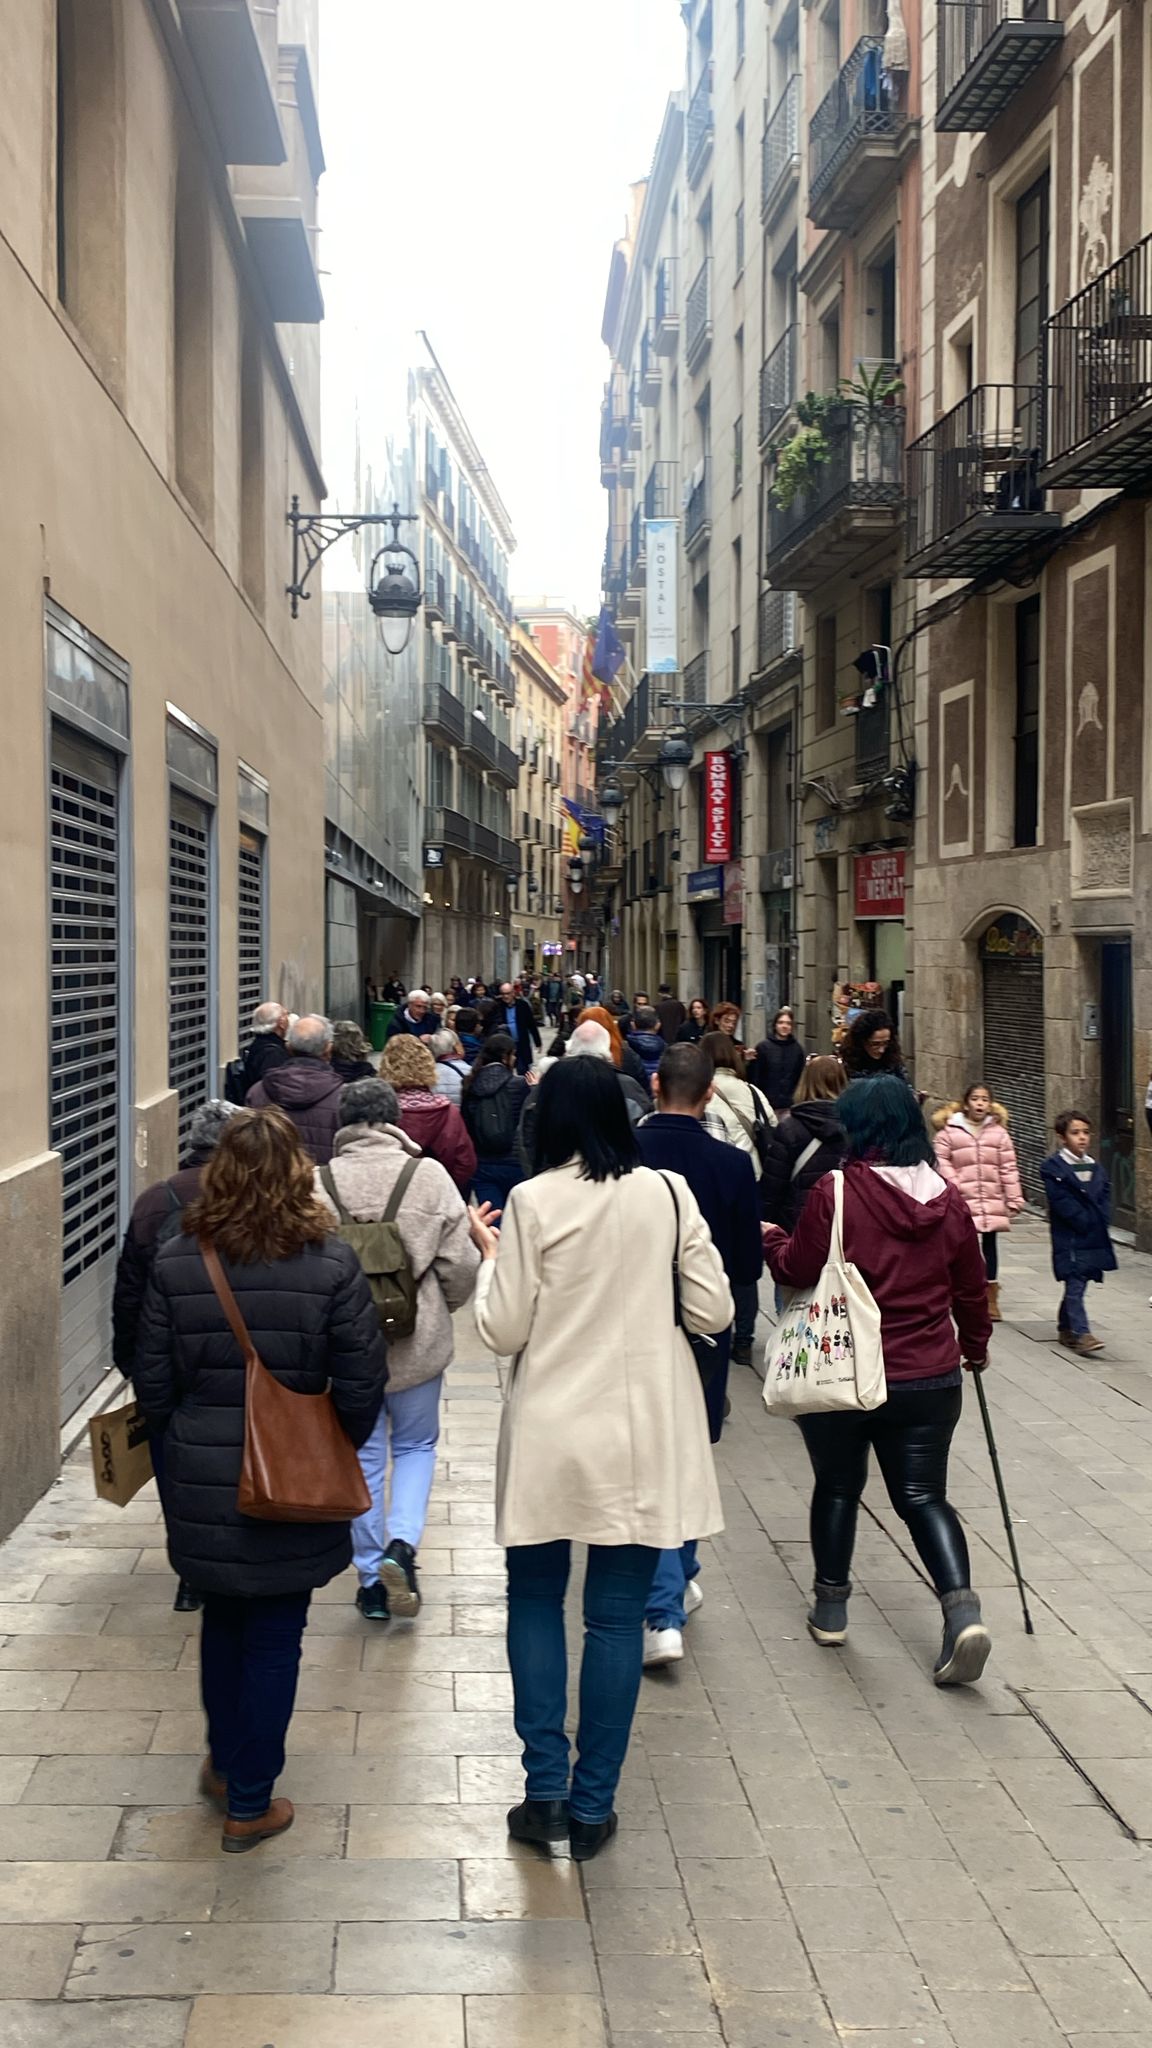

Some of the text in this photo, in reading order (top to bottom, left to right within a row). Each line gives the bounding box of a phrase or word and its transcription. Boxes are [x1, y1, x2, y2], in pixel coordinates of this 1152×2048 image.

[656, 543, 666, 615] HOSTAL
[710, 756, 726, 804] BOMBAY
[710, 807, 726, 847] SPICY
[871, 858, 897, 878] SUPER
